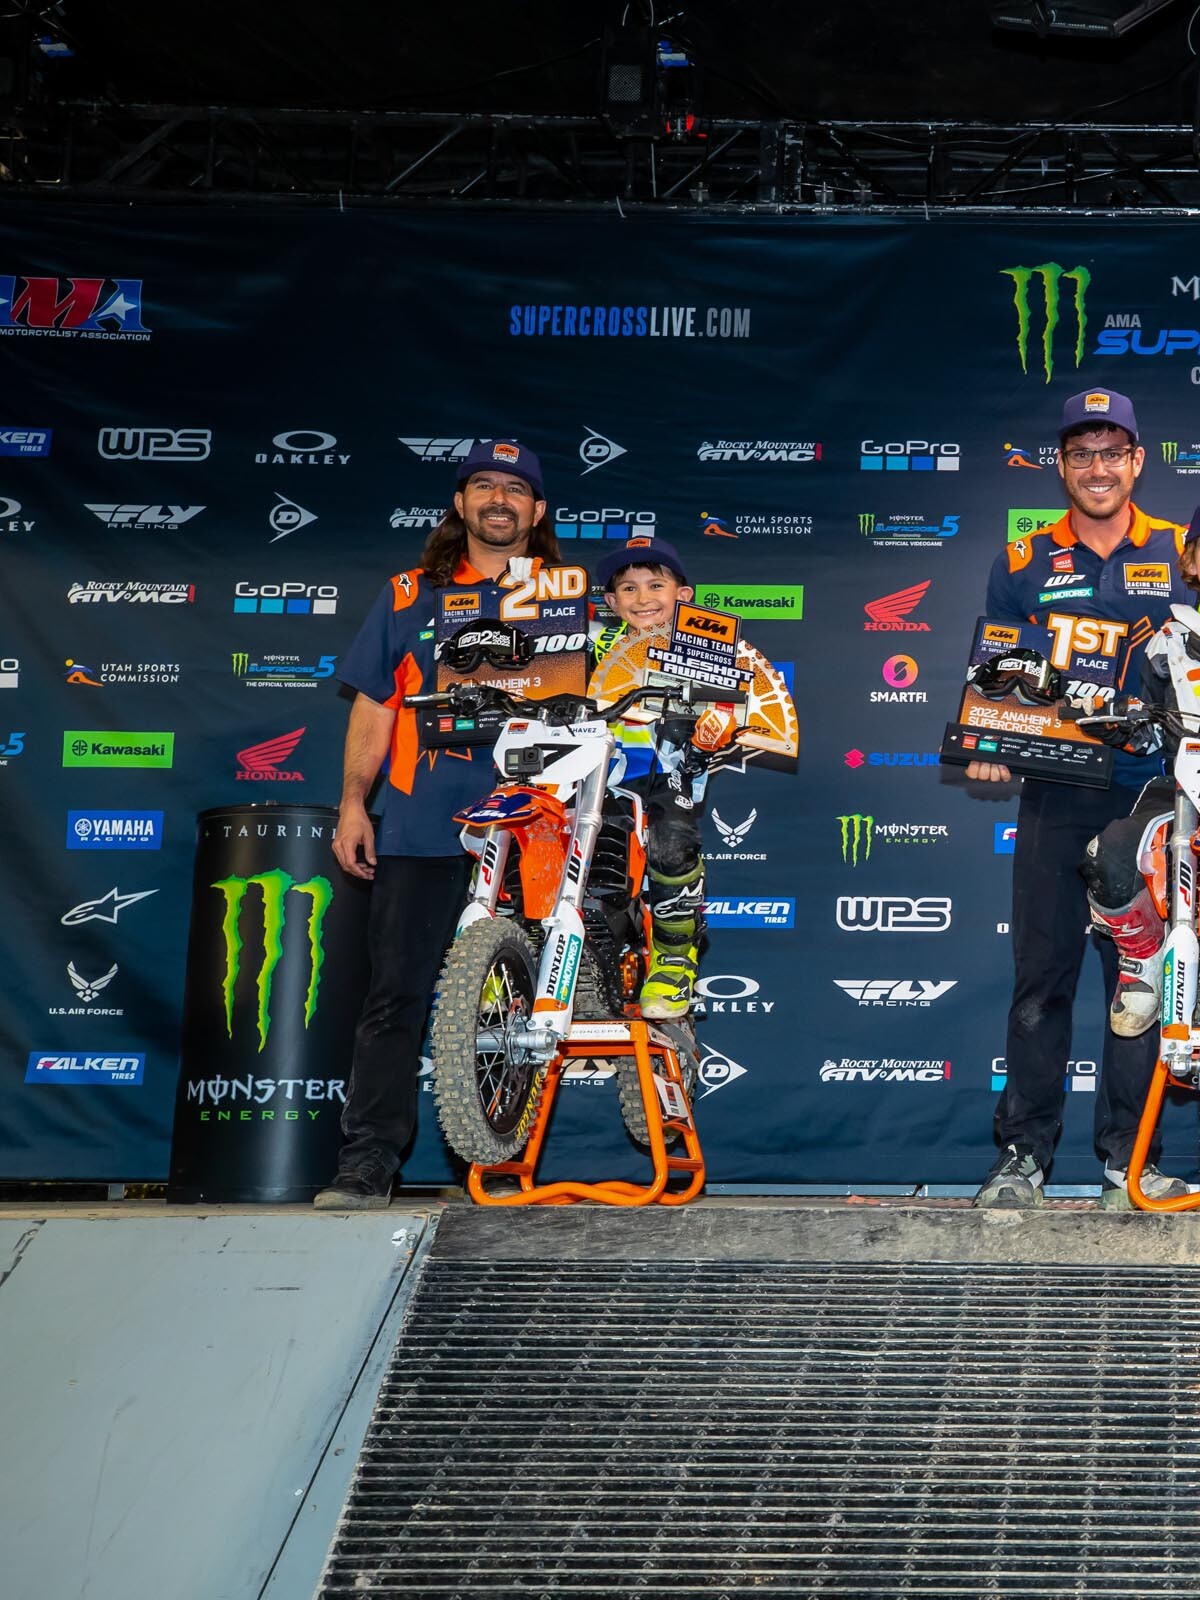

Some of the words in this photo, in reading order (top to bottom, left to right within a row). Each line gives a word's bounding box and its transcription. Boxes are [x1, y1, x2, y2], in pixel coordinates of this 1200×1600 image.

[510, 305, 751, 338] SUPERCROSSLIVE.COM
[1104, 314, 1142, 328] AMA
[0, 329, 79, 339] MOTORCYCLIST
[80, 331, 151, 342] ASSOCIATION
[98, 428, 212, 461] WPS
[716, 440, 753, 450] ROCKY
[754, 441, 816, 450] MOUNTAIN
[860, 440, 960, 456] GoPro
[255, 453, 351, 465] OAKLEY
[409, 507, 447, 516] ROCKY
[555, 507, 656, 523] GoPro
[735, 515, 767, 525] UTAH
[770, 516, 813, 525] SPORTS
[936, 515, 960, 537] 5
[735, 526, 812, 535] COMMISSION
[1132, 569, 1163, 578] KTM
[86, 580, 128, 591] ROCKY
[129, 581, 189, 592] MOUNTAIN
[1043, 574, 1086, 588] WP
[234, 581, 339, 598] GoPro
[501, 566, 586, 620] 2ND
[1052, 588, 1091, 600] MOTOREX
[1137, 590, 1170, 598] SUPERCROSS
[449, 597, 475, 607] KTM
[723, 596, 795, 608] Kawasaki
[542, 606, 576, 618] PLACE
[685, 616, 729, 636] KTM
[864, 622, 931, 631] HONDA
[988, 629, 1015, 640] KTM
[533, 632, 587, 653] 100
[675, 632, 708, 648] RACING
[710, 641, 734, 654] TEAM
[982, 639, 1002, 648] RACING
[1049, 615, 1127, 669] 1ST
[686, 648, 732, 666] SUPERCROSS
[1076, 657, 1109, 670] PLACE
[101, 663, 133, 673] UTAH
[137, 664, 180, 673] SPORTS
[311, 655, 338, 678] 5
[648, 648, 755, 682] HOLESHOT
[100, 673, 179, 683] COMMISSION
[533, 677, 542, 687] 3
[663, 664, 737, 689] AWARD
[969, 705, 998, 720] 2022
[1000, 710, 1052, 726] ANAHEIM
[1054, 719, 1062, 729] 3
[967, 716, 1043, 736] SUPERCROSS
[91, 743, 165, 756] Kawasaki
[235, 771, 304, 781] HONDA
[93, 819, 154, 836] YAMAHA
[875, 823, 948, 836] MONSTER
[836, 897, 952, 932] WPS
[546, 933, 566, 997] DUNLOP
[1175, 959, 1186, 1022] DUNLOP
[86, 1008, 124, 1016] FORCE
[36, 1057, 139, 1071] FALKEN
[839, 1059, 878, 1069] ROCKY
[880, 1059, 944, 1069] MOUNTAIN
[187, 1073, 347, 1106] MONSTER
[200, 1110, 321, 1121] ENERGY
